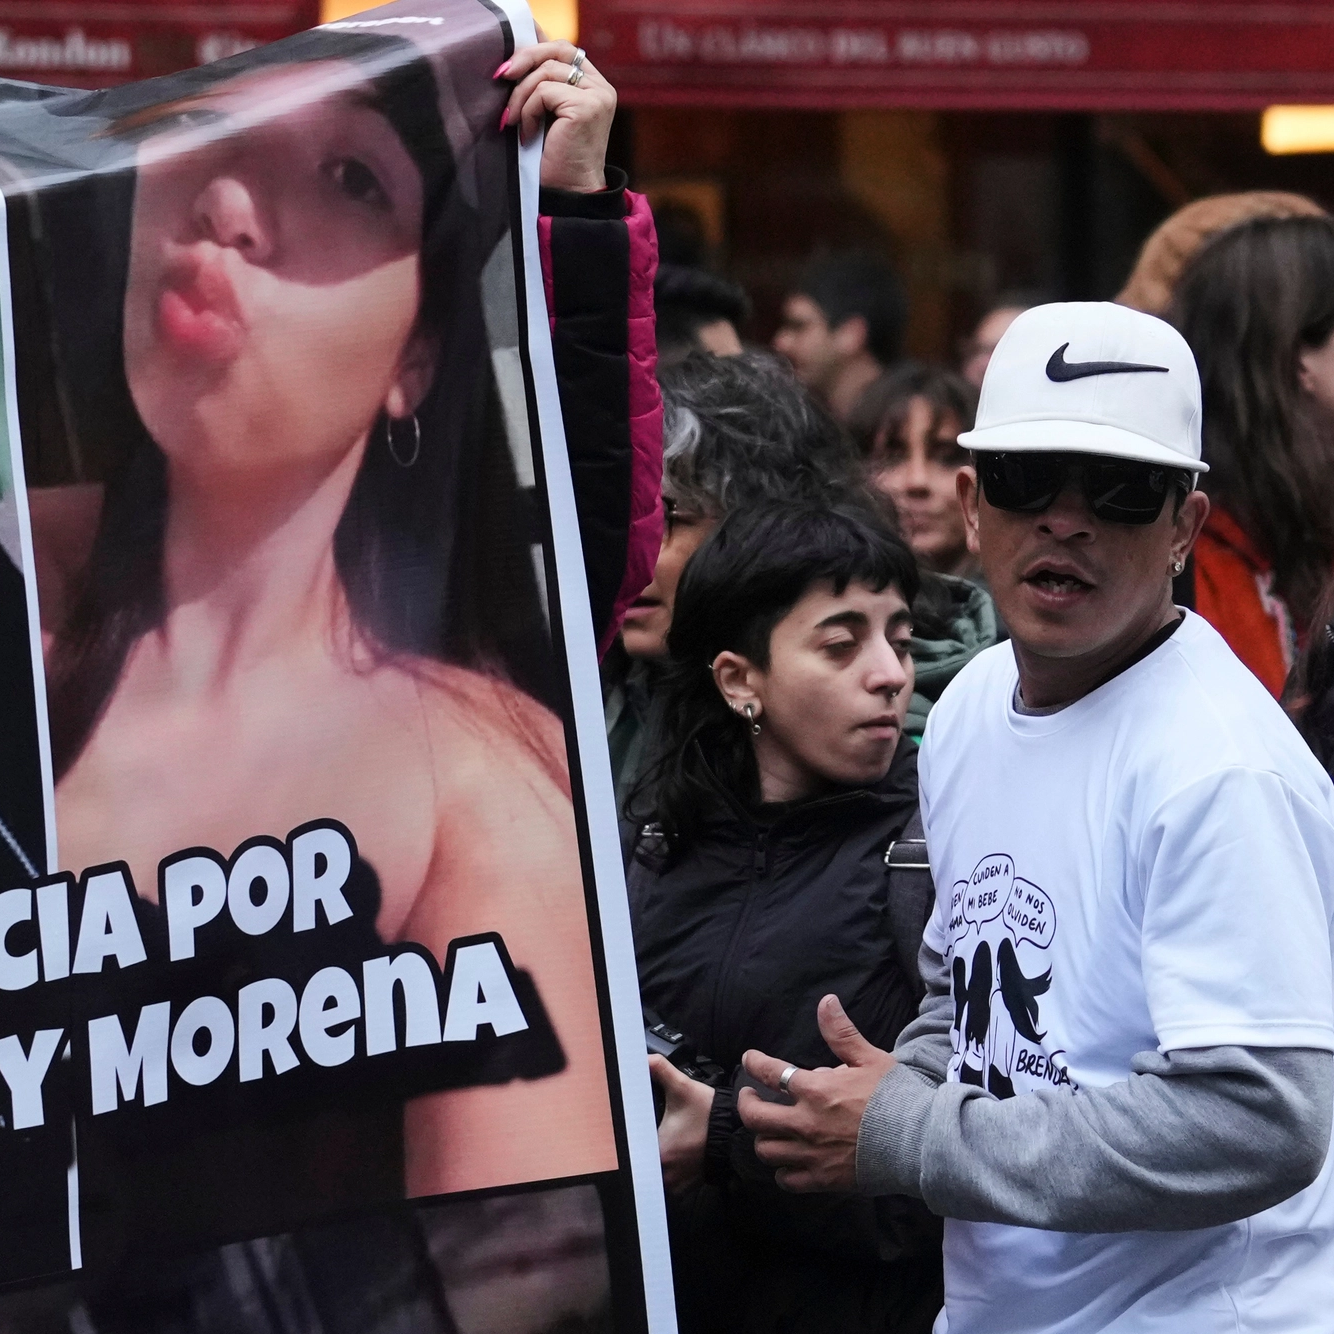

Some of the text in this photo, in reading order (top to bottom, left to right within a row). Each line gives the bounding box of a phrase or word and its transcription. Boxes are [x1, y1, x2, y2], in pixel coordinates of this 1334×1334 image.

[972, 863, 1010, 886] CUIDEN A
[164, 827, 355, 962] POR
[967, 897, 976, 911] MI
[977, 889, 999, 909] BEBE
[1013, 885, 1045, 915] NO NOS
[1007, 902, 1047, 935] OLVIDEN
